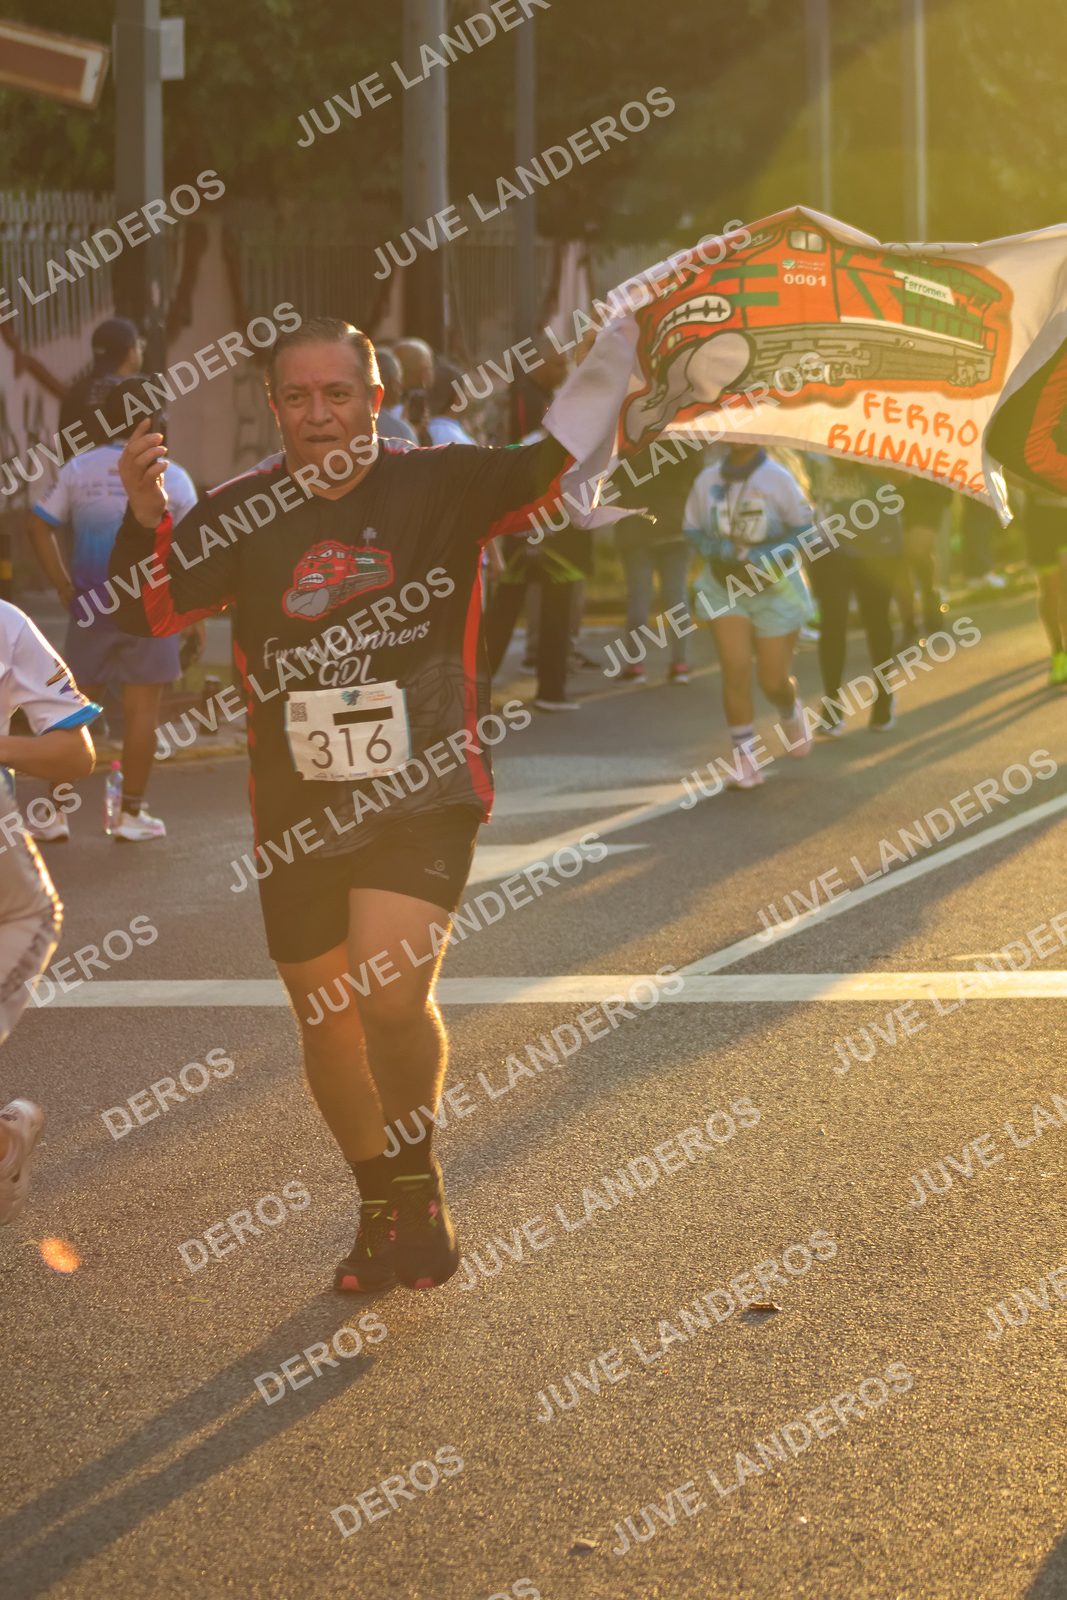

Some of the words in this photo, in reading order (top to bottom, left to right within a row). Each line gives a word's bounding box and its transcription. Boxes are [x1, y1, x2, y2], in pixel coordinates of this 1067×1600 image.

[783, 273, 827, 287] 0001
[863, 392, 979, 447] FERRO
[318, 654, 377, 687] GDL
[308, 724, 392, 769] 316
